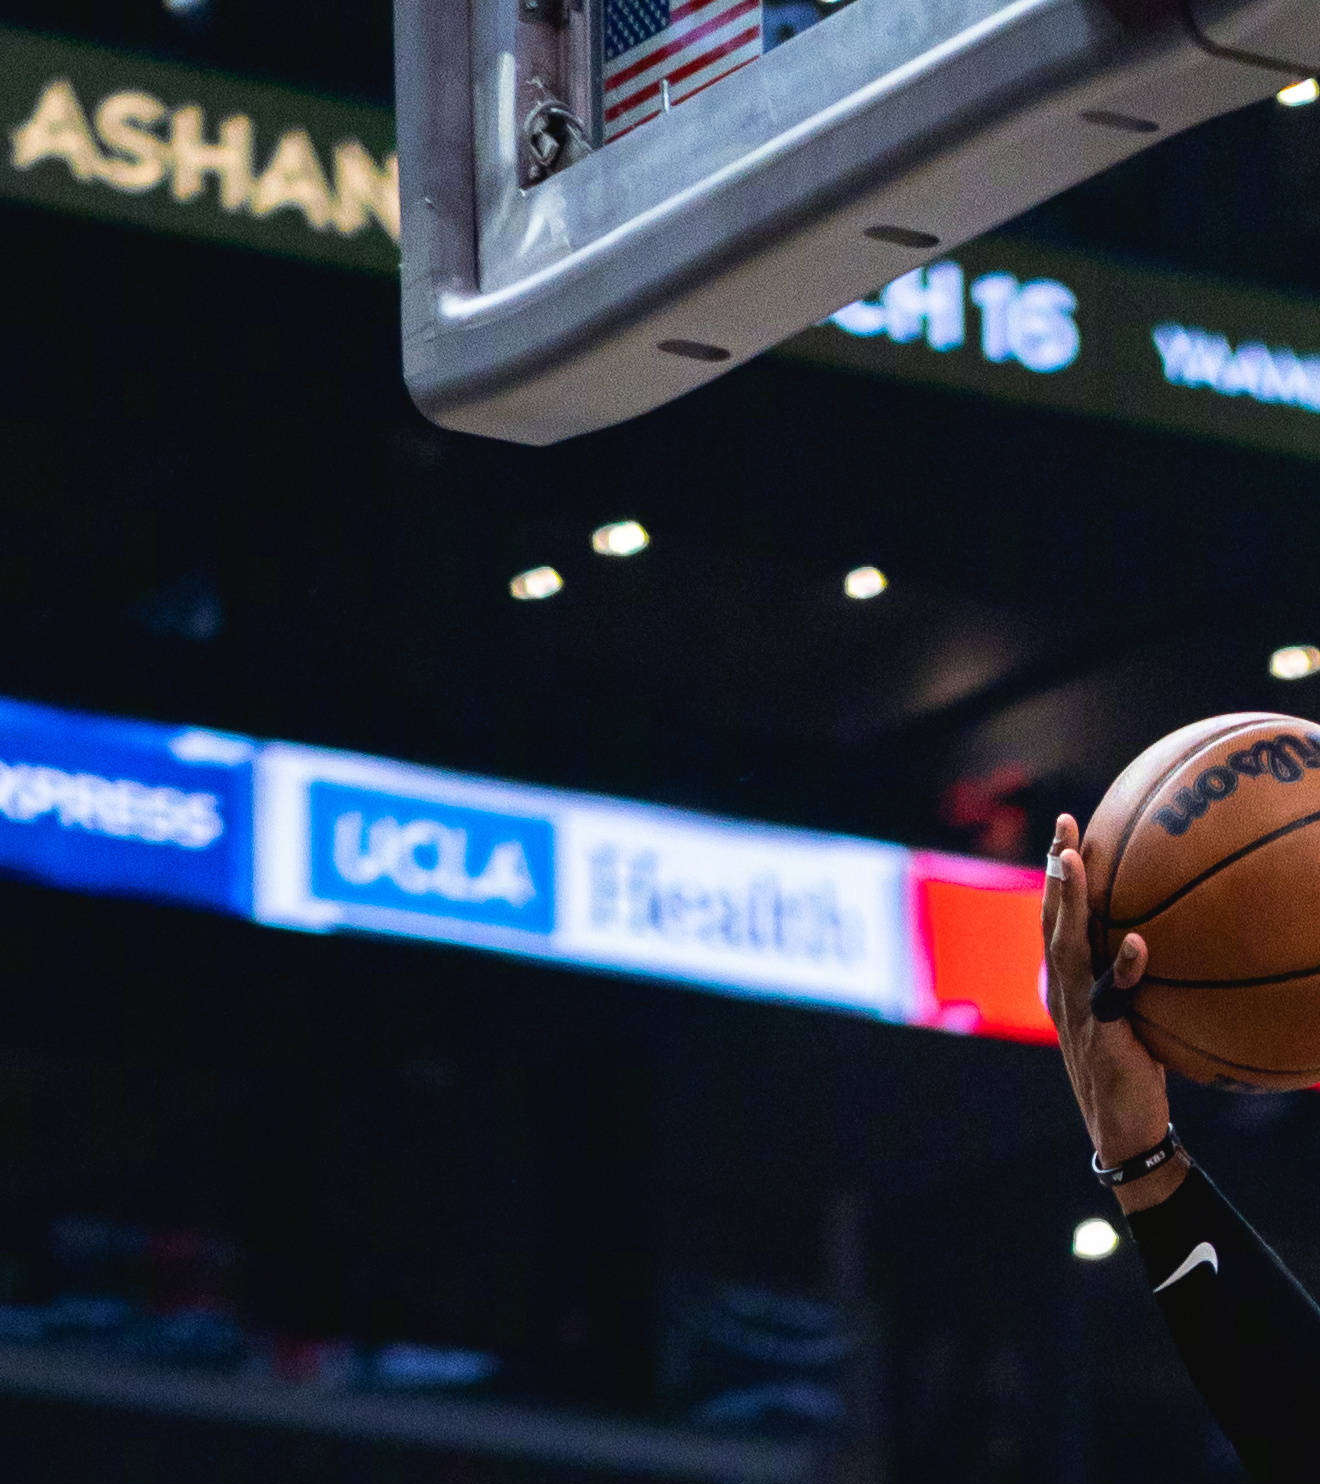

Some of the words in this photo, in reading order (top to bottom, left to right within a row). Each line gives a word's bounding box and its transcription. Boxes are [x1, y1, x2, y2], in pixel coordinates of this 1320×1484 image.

[972, 268, 1082, 374] 16
[332, 810, 539, 908] UCLA
[588, 843, 868, 967] Health
